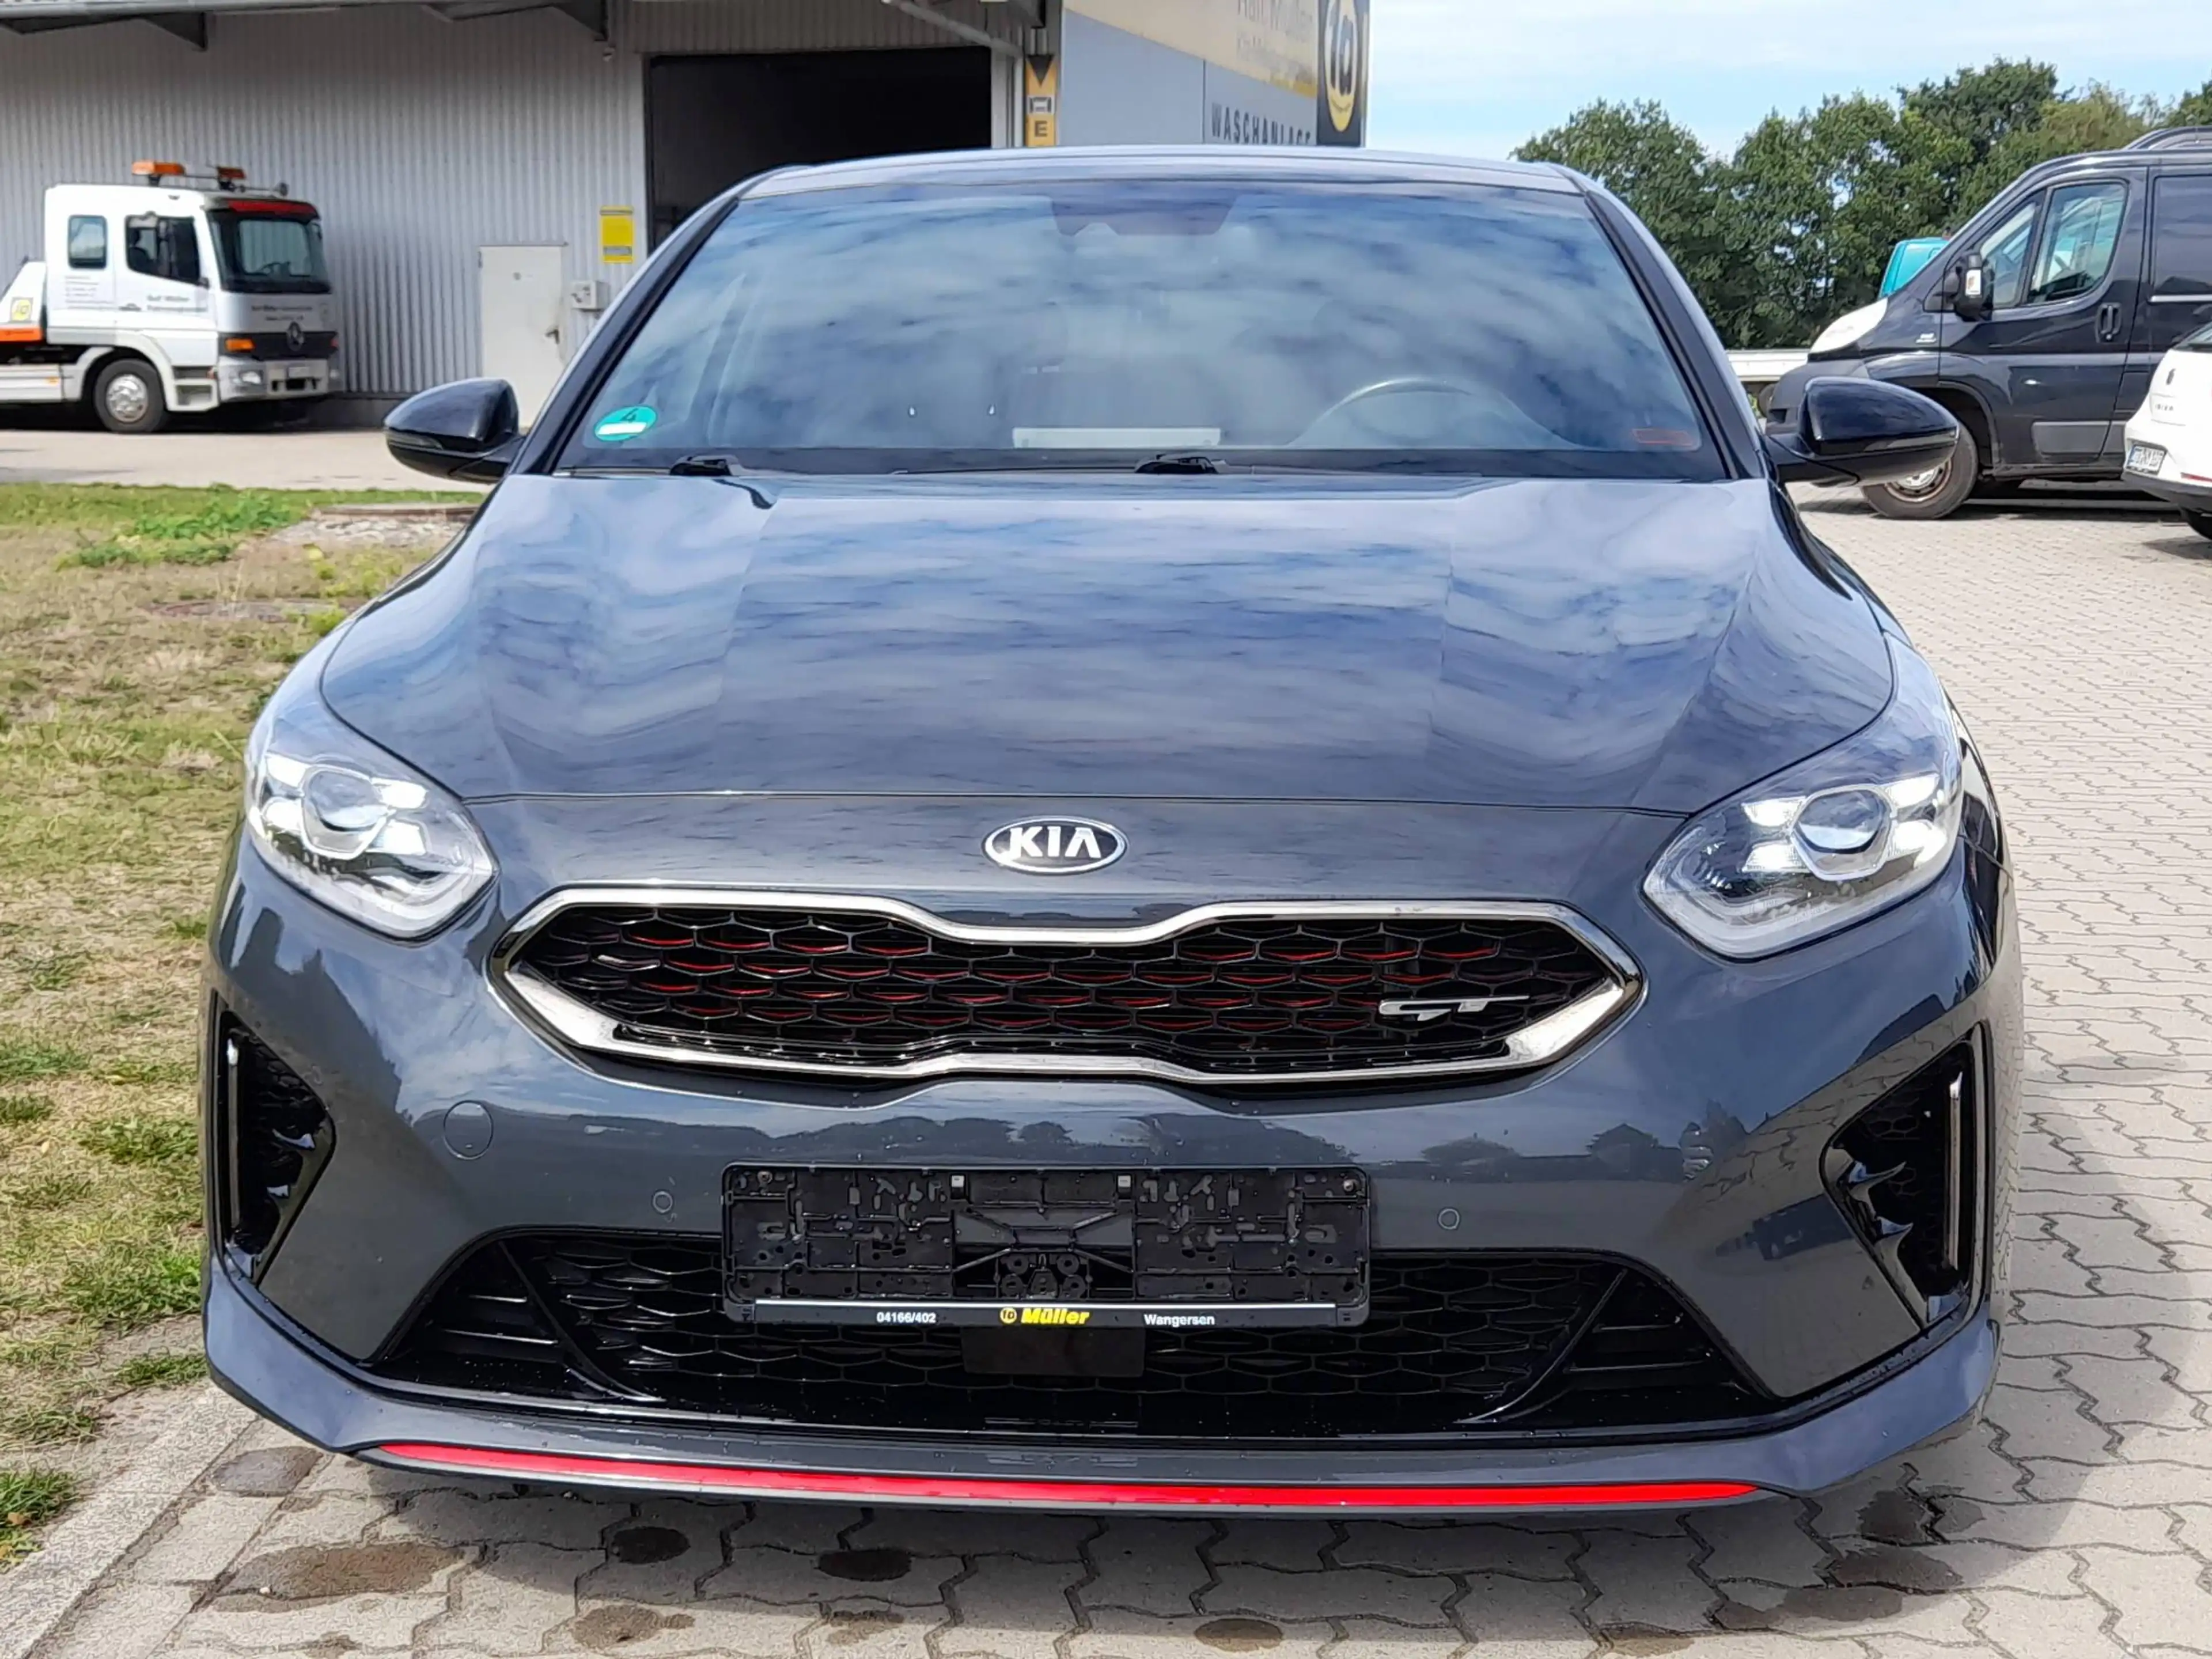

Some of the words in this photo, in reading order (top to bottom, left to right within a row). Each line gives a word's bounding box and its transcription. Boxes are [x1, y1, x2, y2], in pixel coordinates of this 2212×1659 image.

[1034, 120, 1048, 137] E
[1010, 825, 1101, 858] KIA
[876, 1312, 936, 1323] 04166/402
[1021, 1307, 1090, 1324] Müller
[1143, 1313, 1215, 1328] Wangersen
